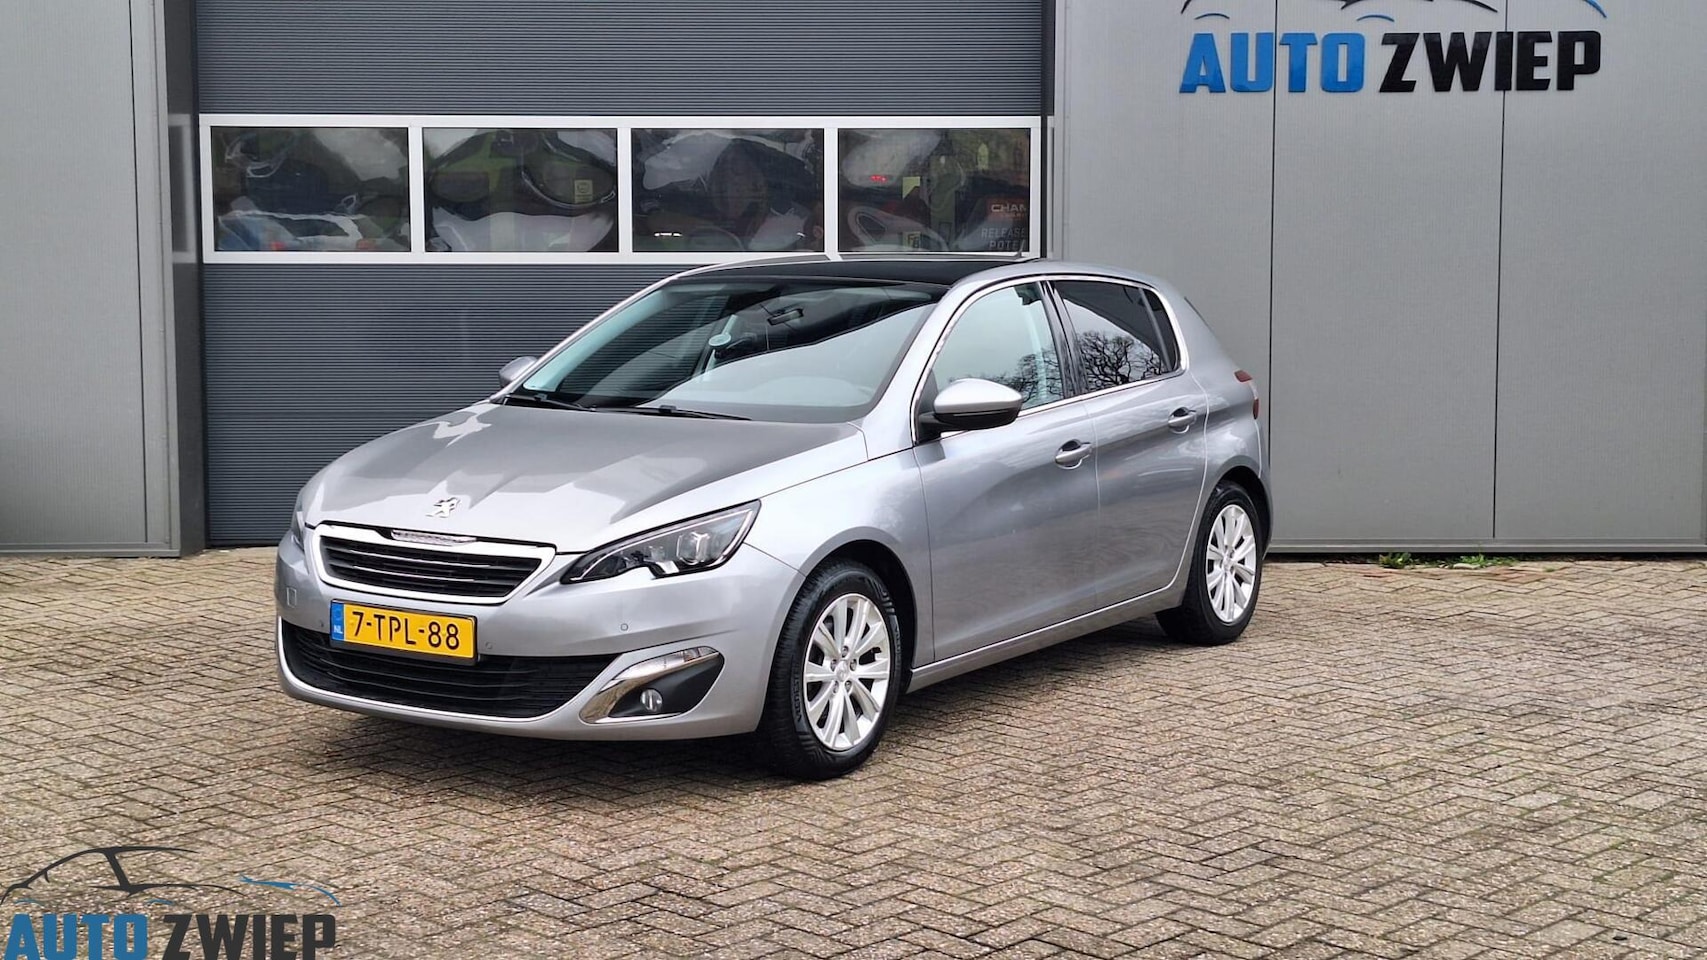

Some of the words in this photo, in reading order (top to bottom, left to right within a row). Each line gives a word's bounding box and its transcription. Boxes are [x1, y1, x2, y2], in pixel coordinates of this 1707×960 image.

[1179, 32, 1365, 93] AUTO
[1379, 30, 1601, 93] ZWIEP
[989, 240, 1025, 250] POTE
[333, 624, 344, 634] NL
[352, 611, 460, 650] 7-TPL-88
